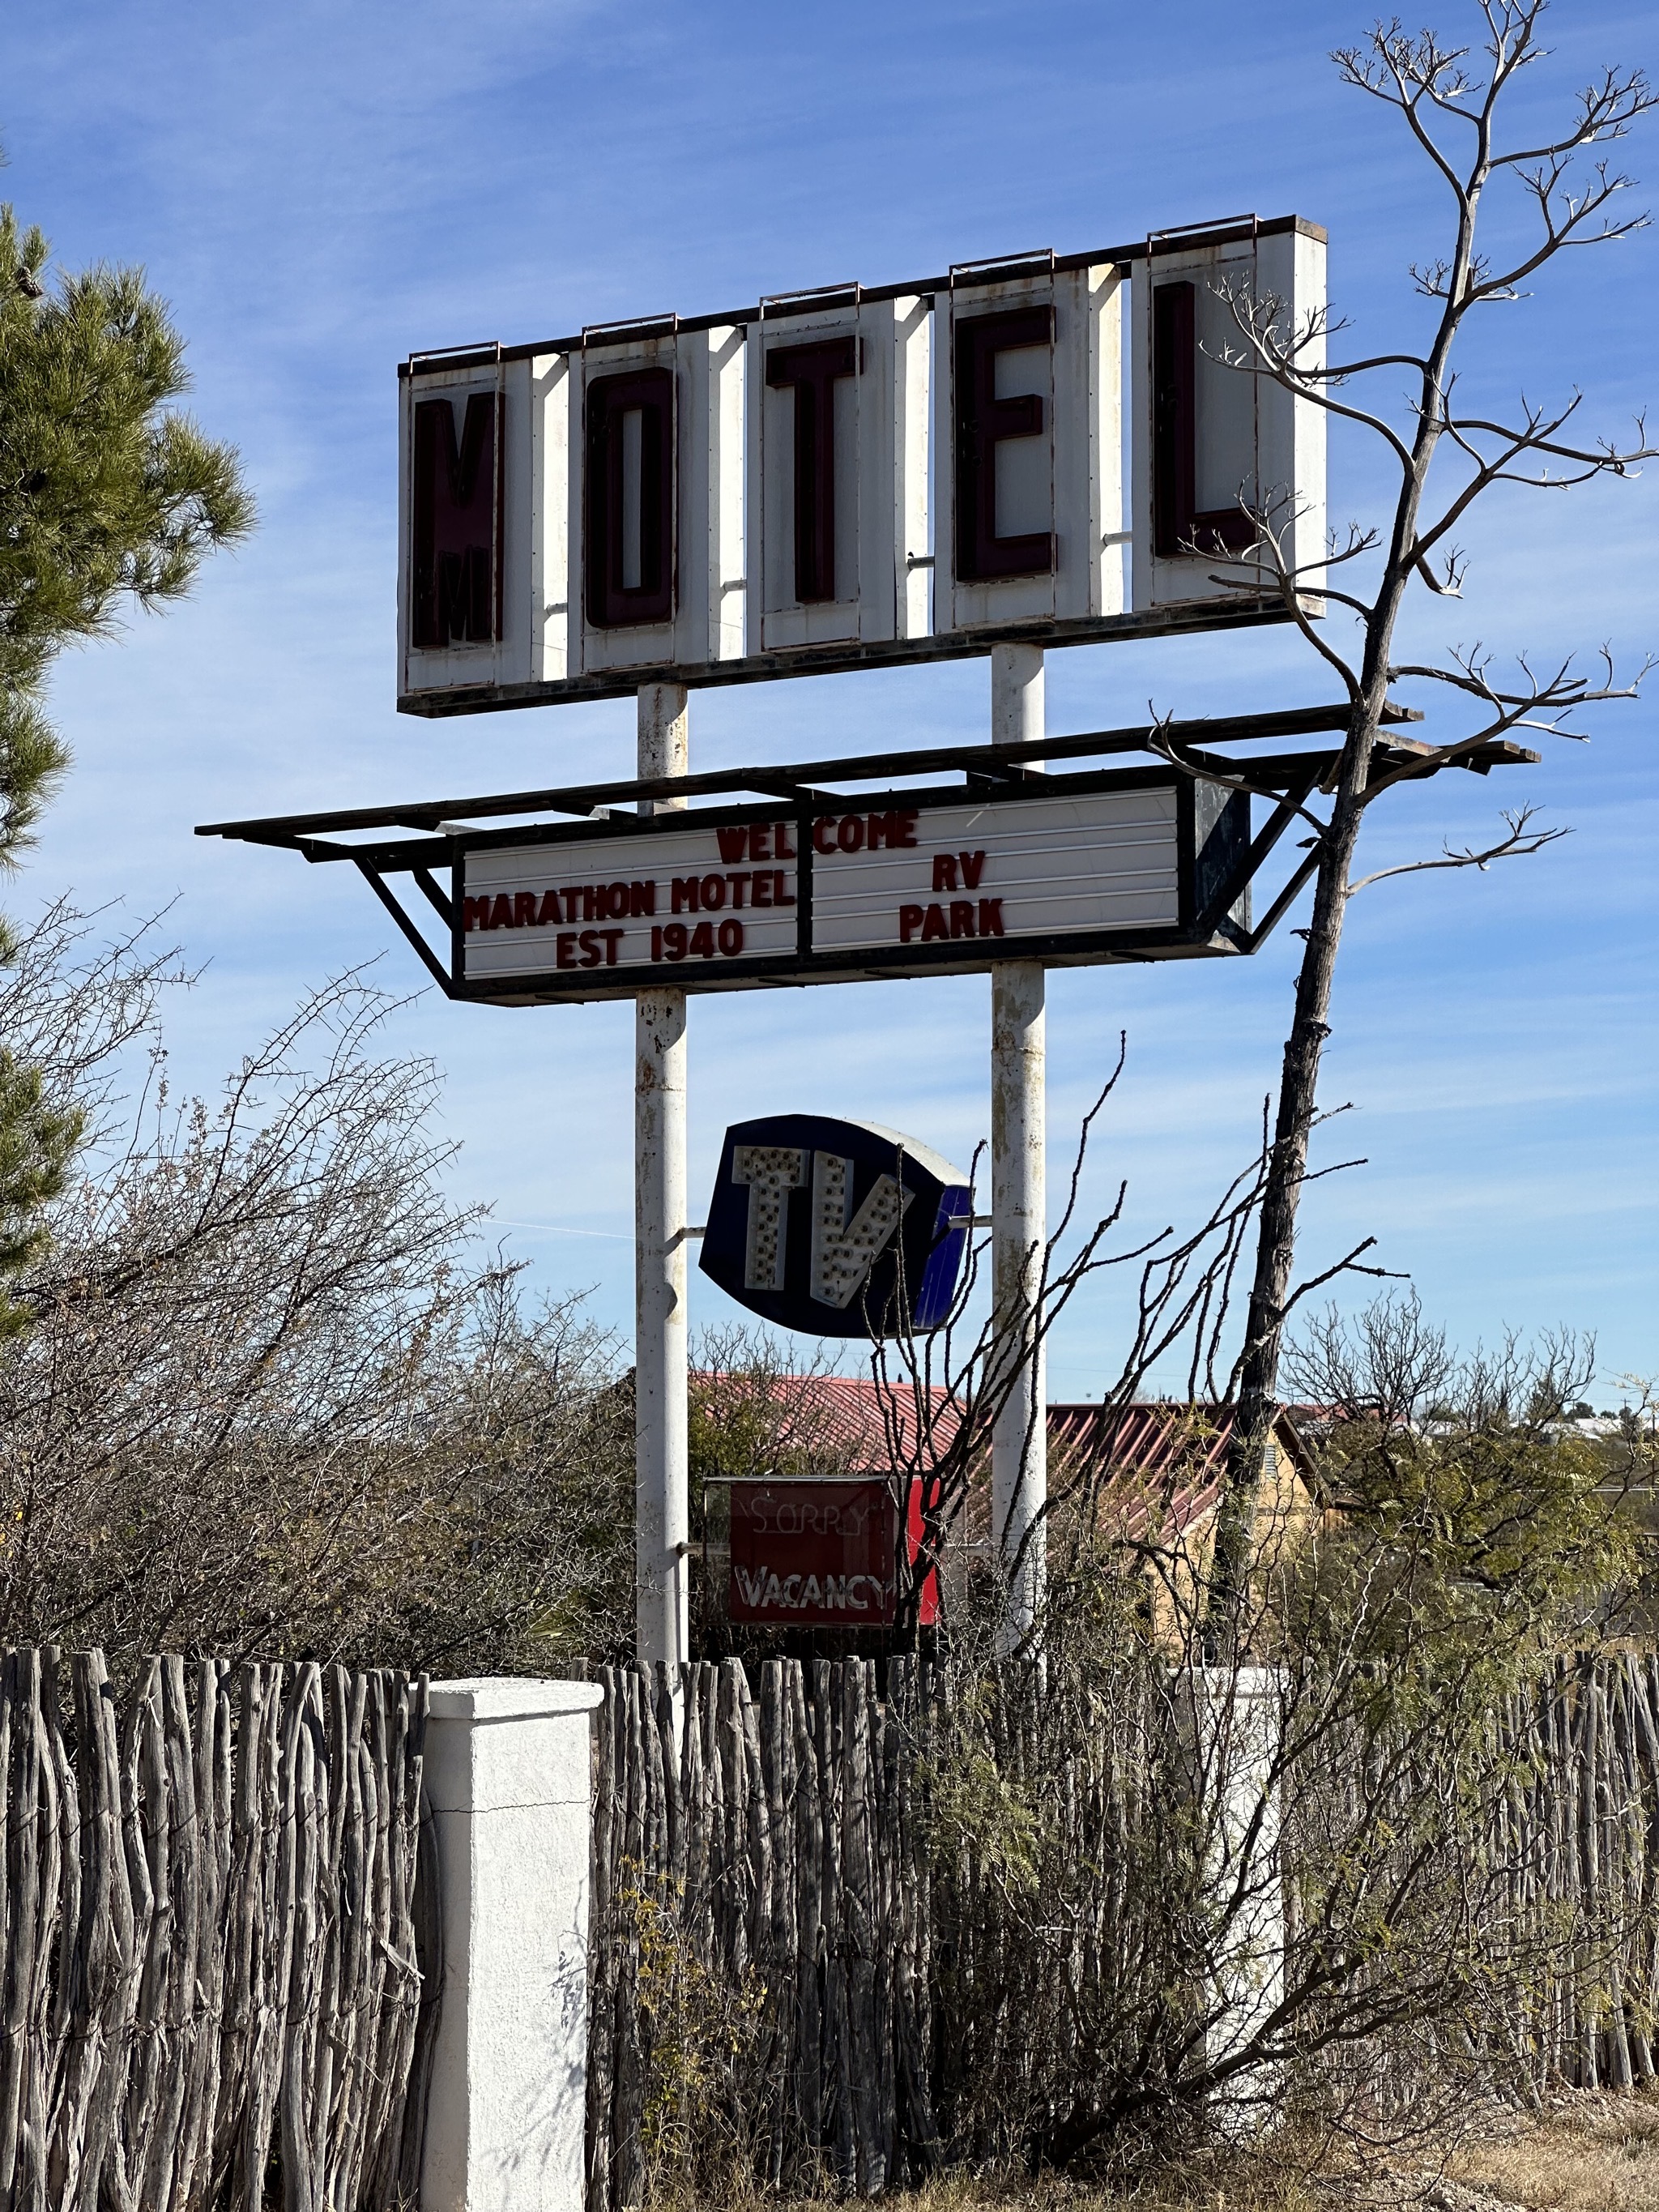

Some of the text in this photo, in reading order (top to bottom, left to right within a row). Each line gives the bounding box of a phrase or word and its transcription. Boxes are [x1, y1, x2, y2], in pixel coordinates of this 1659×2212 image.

[412, 281, 1258, 648] MOTEL
[932, 851, 985, 891] RV
[463, 869, 795, 932] MARATHON MOTEL
[899, 898, 1004, 943] PARK
[557, 918, 744, 969] EST 1940
[731, 1146, 915, 1309] TV
[734, 1565, 896, 1610] VACANCY
